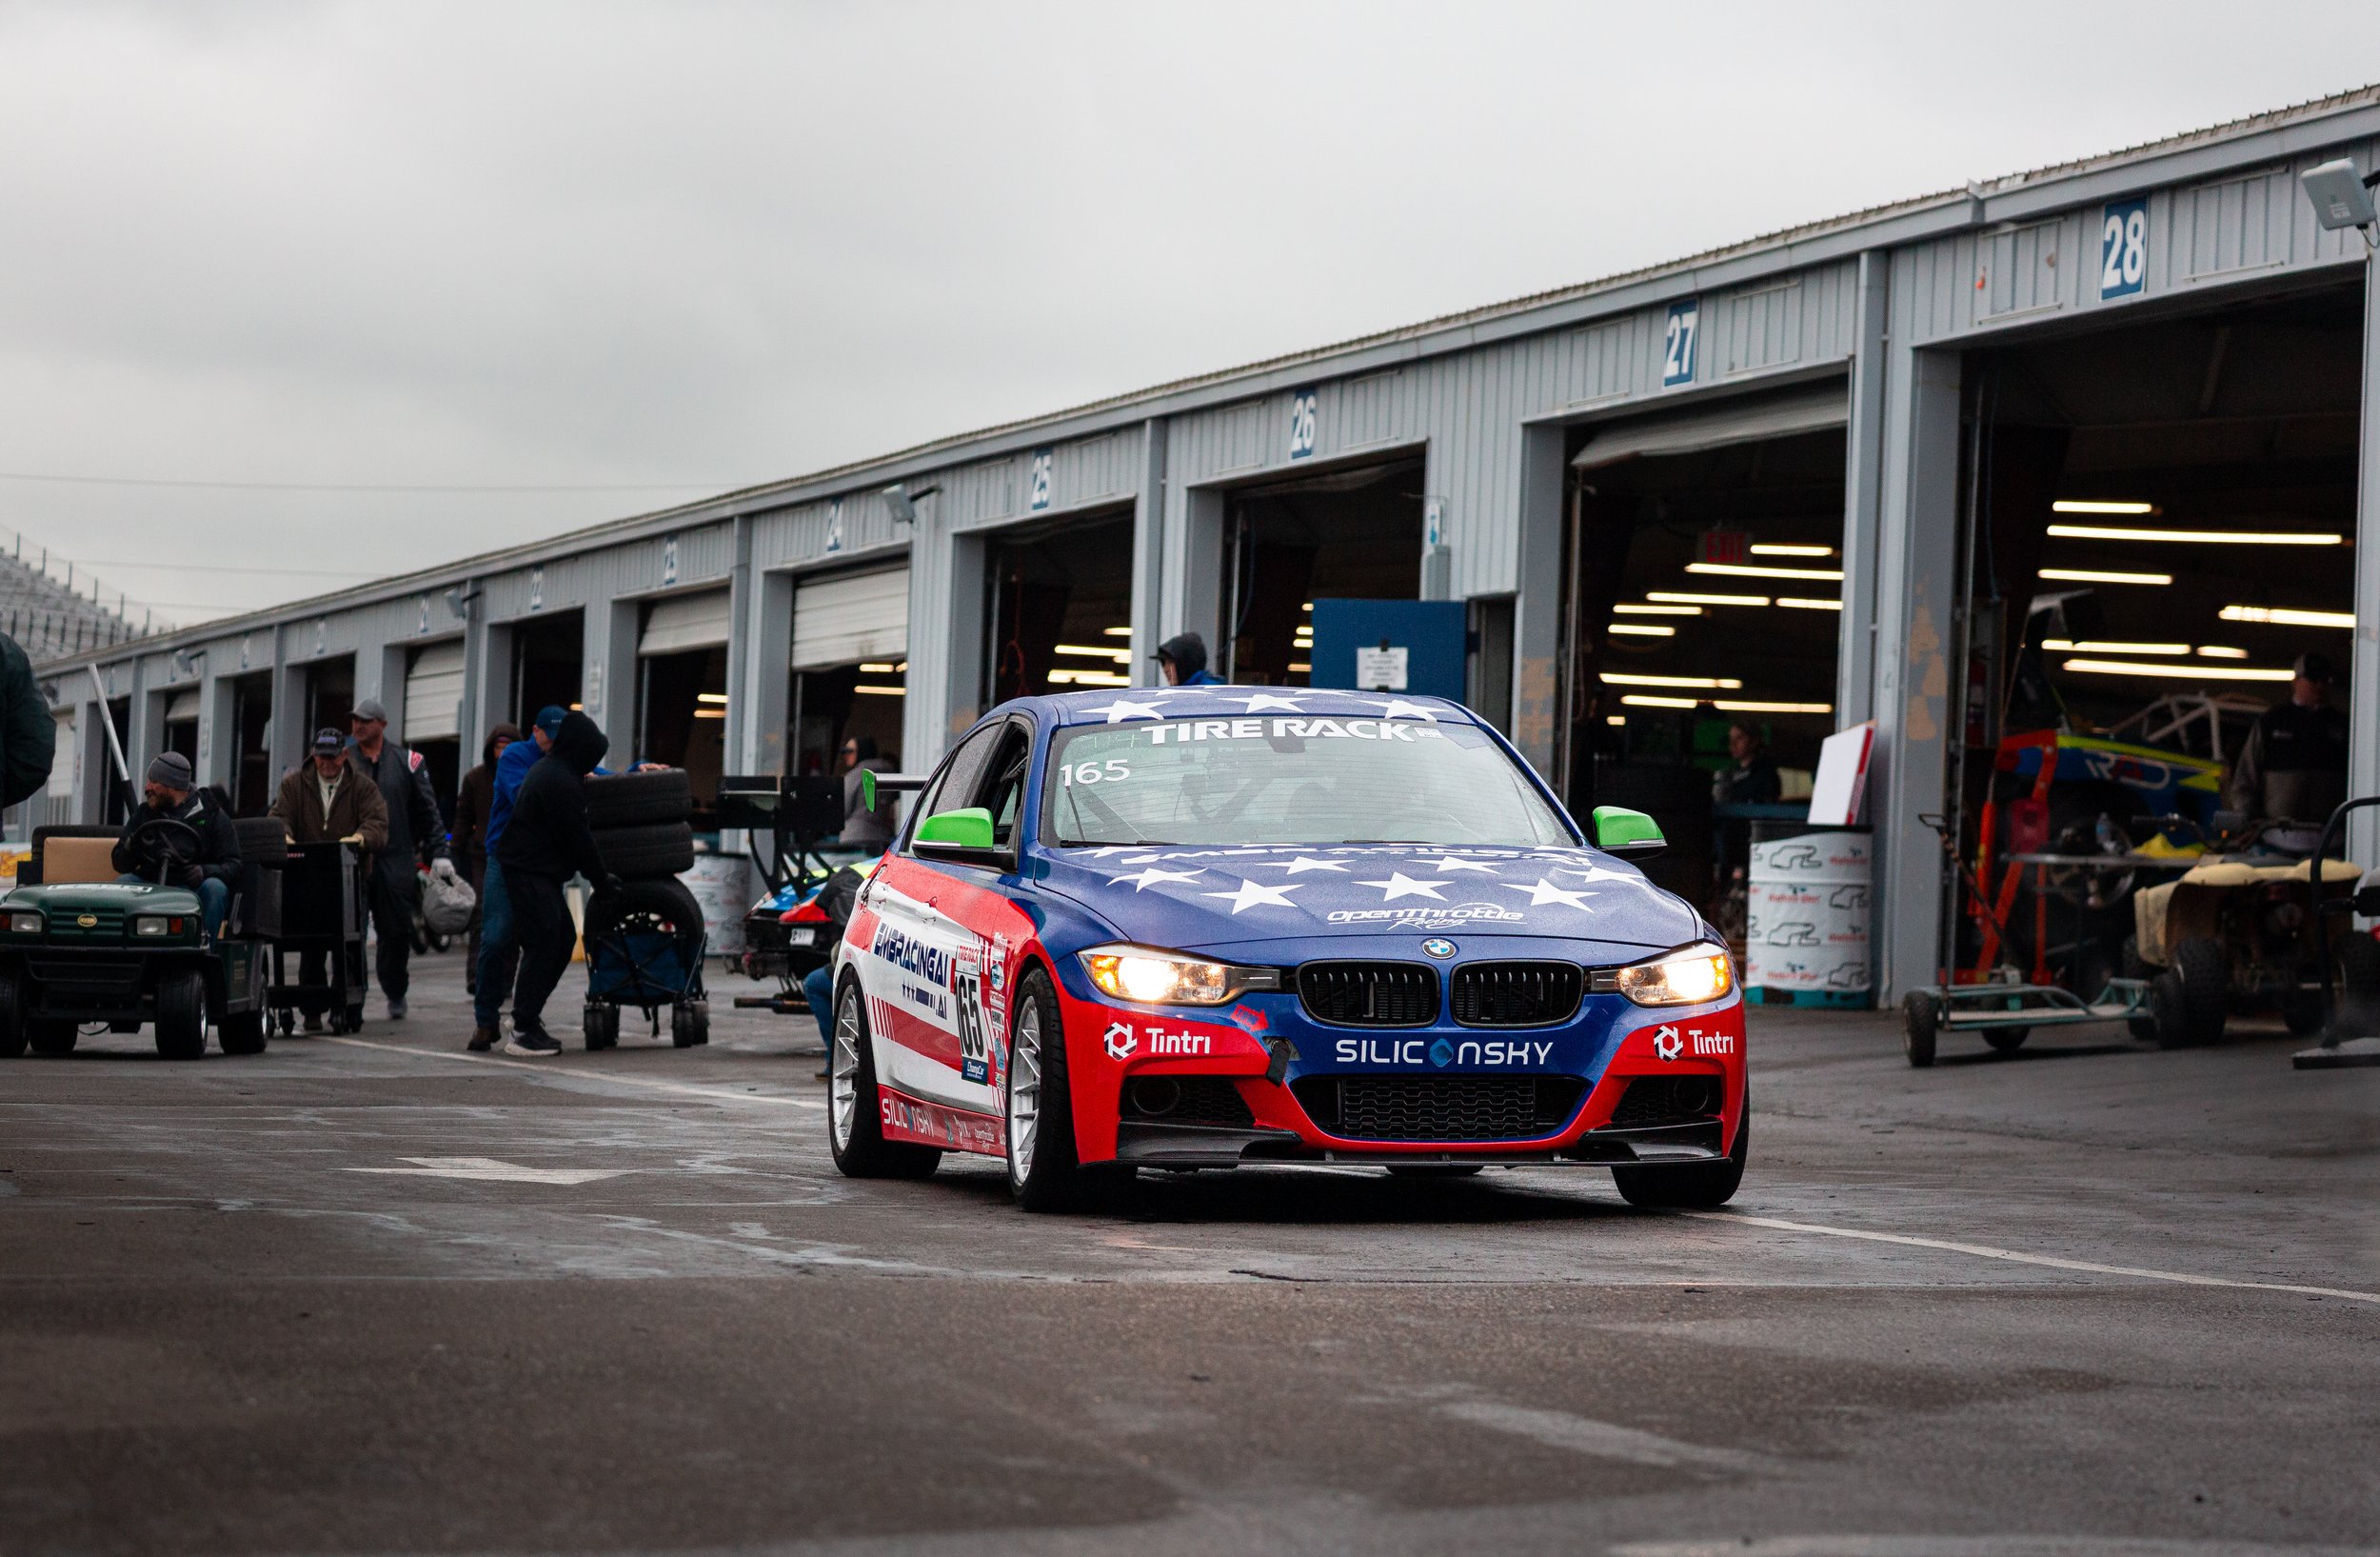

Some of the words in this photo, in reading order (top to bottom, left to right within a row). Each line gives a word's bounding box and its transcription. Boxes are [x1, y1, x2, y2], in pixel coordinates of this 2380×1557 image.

[2102, 210, 2145, 289] 28
[1664, 310, 1697, 378] 27
[1292, 394, 1316, 451] 26
[1031, 454, 1051, 504] 25
[826, 501, 843, 547] 24
[1706, 532, 1743, 564] EXIT
[1140, 719, 1263, 745] TIRE
[1273, 719, 1416, 743] RACK
[1060, 758, 1130, 787] 165
